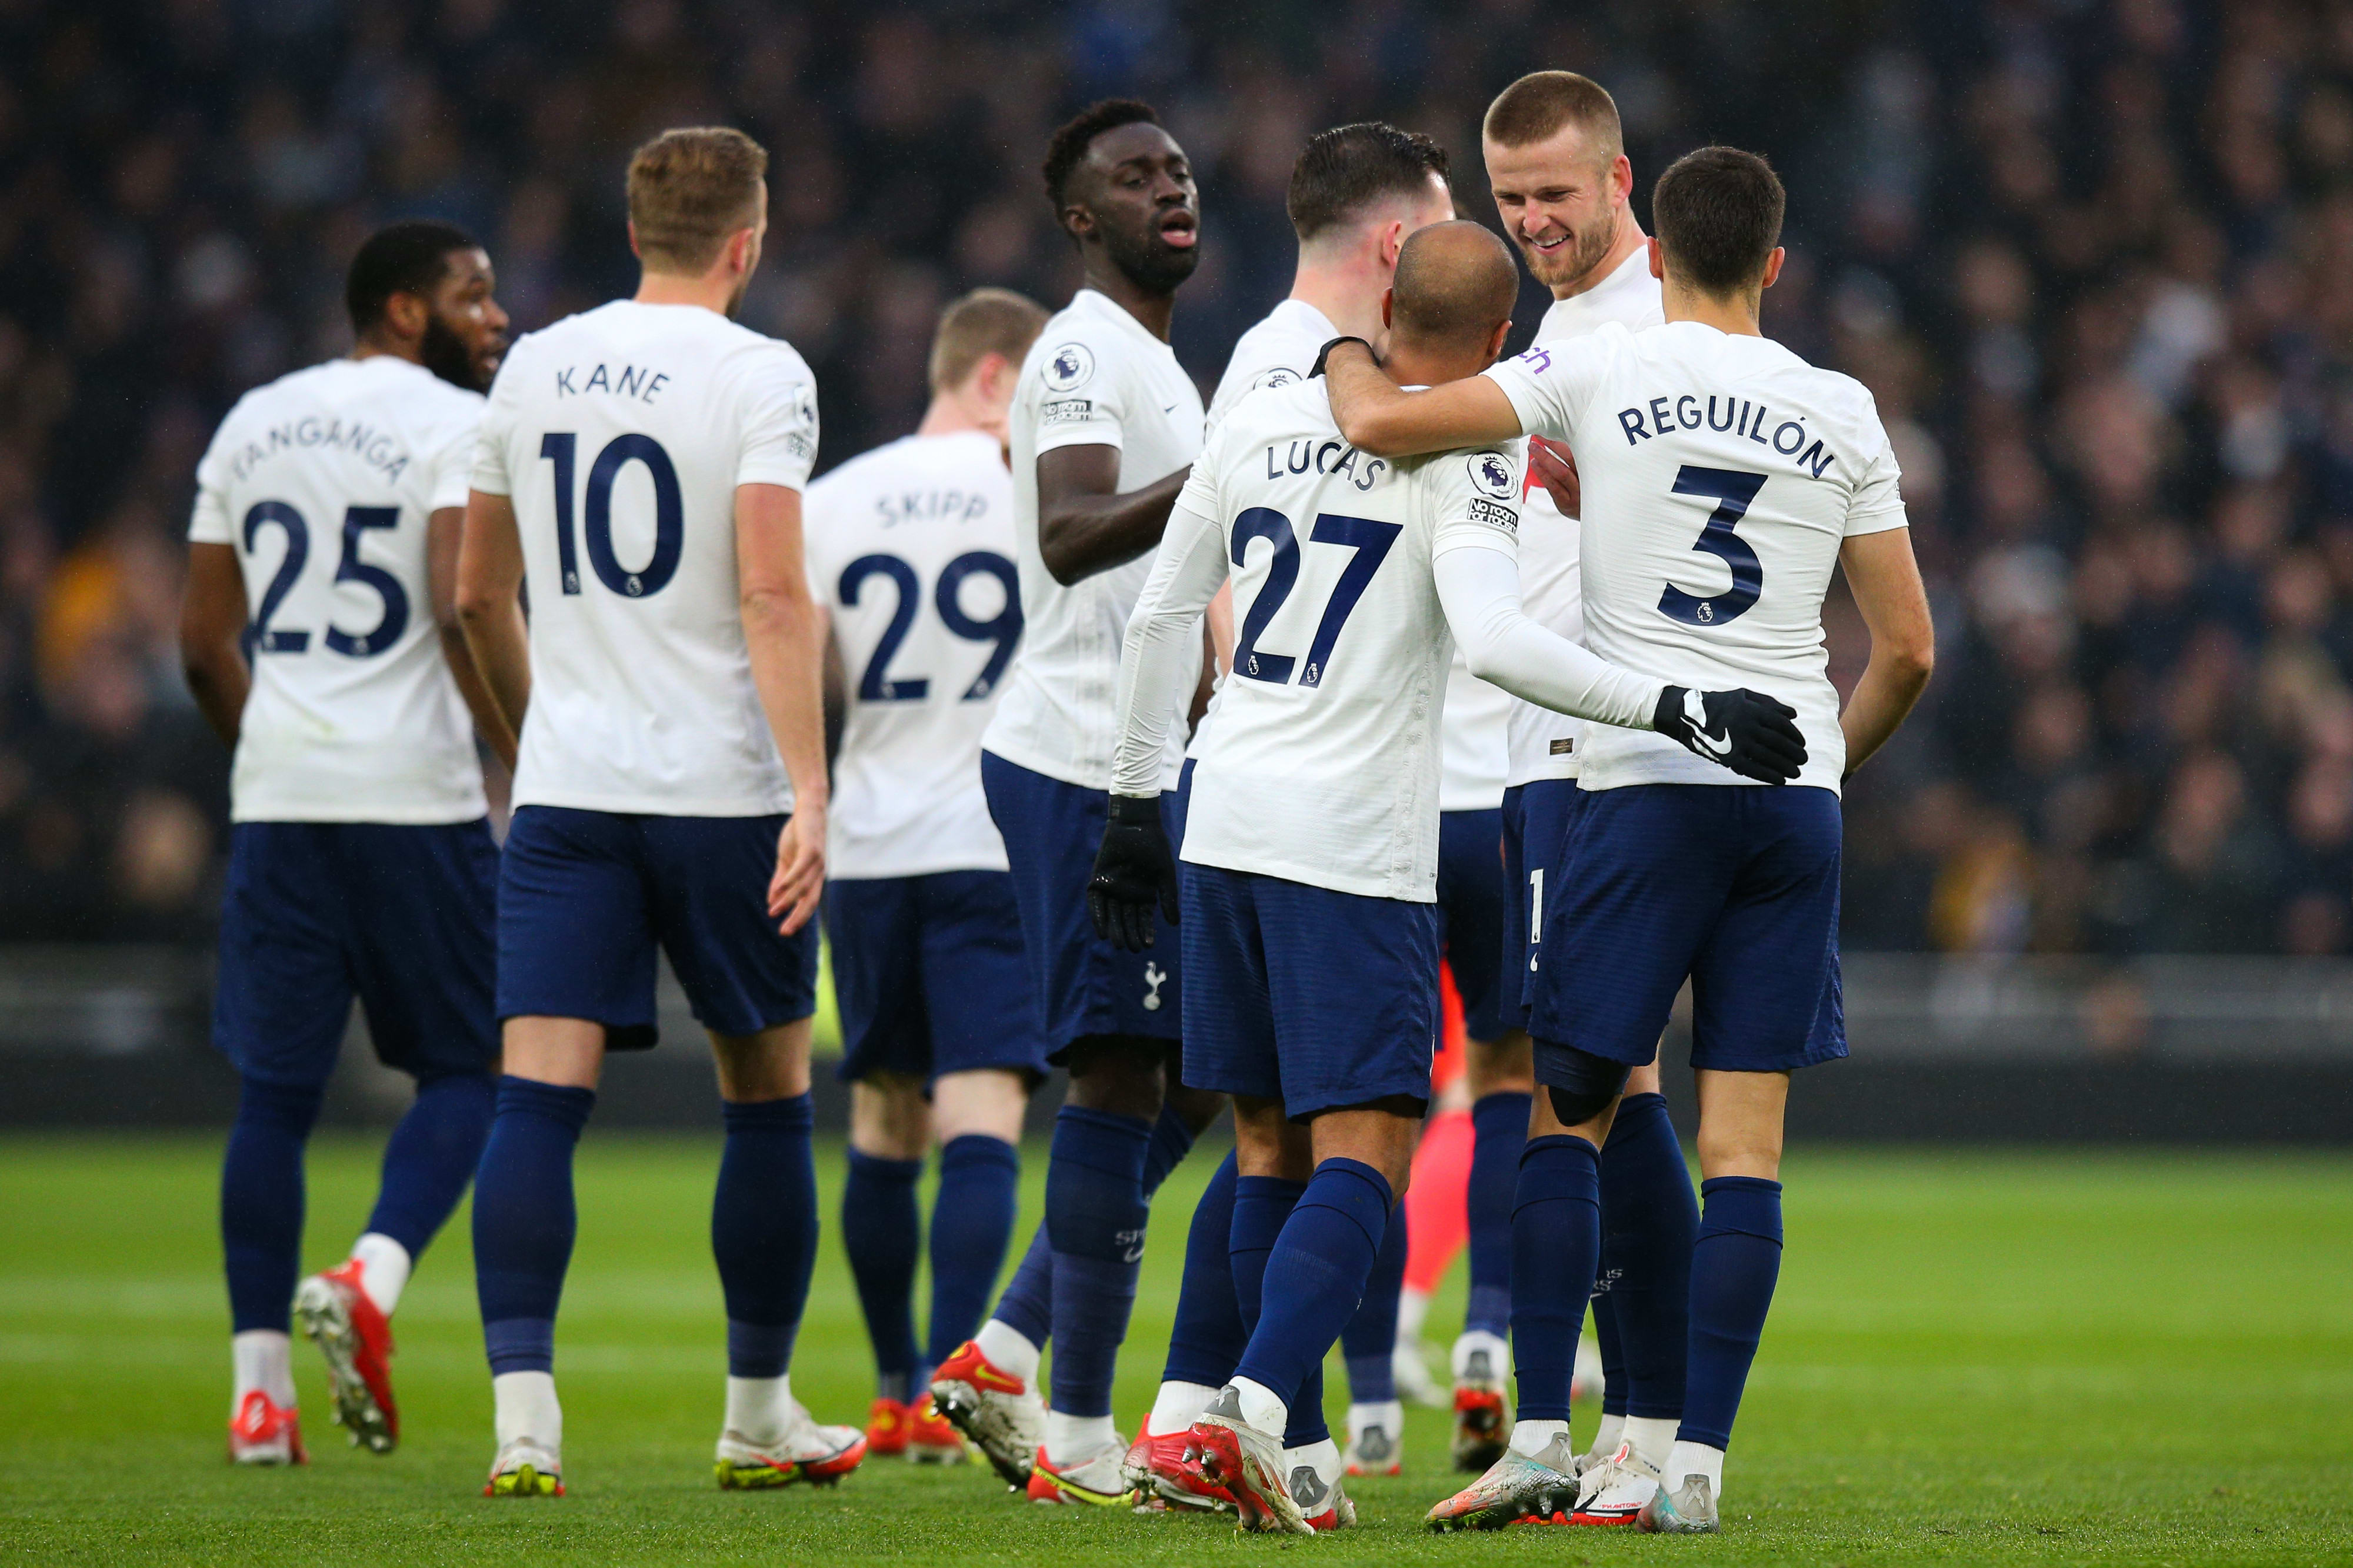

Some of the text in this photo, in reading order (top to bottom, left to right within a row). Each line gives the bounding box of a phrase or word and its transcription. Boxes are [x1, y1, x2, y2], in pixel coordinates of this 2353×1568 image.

[557, 363, 671, 405] KANE
[231, 416, 411, 488] TANGANGA
[1267, 441, 1387, 492] LUCAS
[1618, 395, 1835, 479] REGUILÓN
[541, 432, 684, 598] 10
[876, 489, 989, 528] SKIPP
[1468, 509, 1517, 535] for racism
[1469, 499, 1517, 525] No room
[1657, 465, 1769, 627] 3
[244, 500, 409, 658] 25
[1231, 506, 1404, 688] 27
[839, 551, 1025, 701] 29
